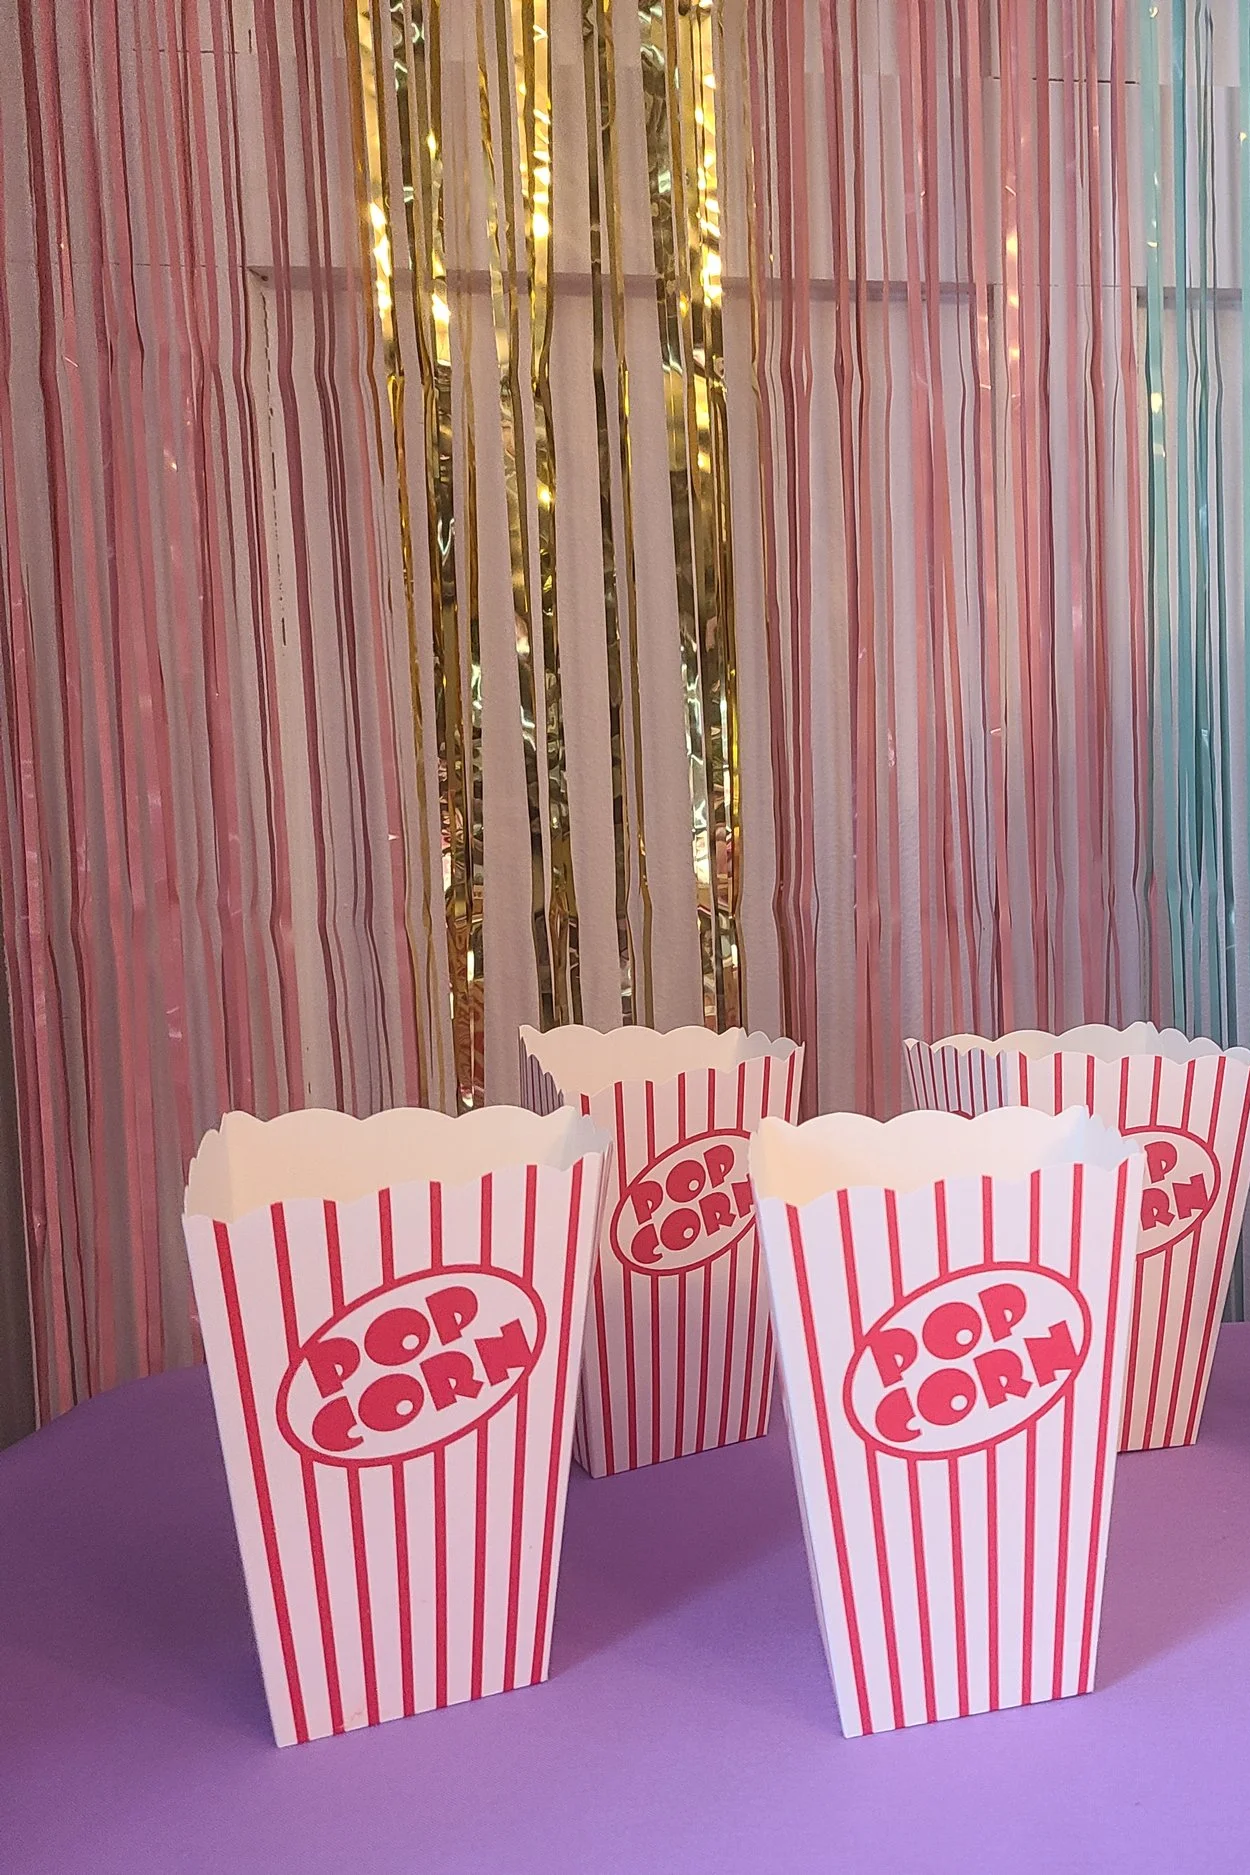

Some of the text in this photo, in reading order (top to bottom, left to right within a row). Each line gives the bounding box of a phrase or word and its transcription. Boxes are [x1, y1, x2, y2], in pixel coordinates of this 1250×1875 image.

[630, 1144, 735, 1224] POP
[630, 1173, 755, 1264] CORN
[1140, 1173, 1210, 1231] RN
[302, 1286, 478, 1398] POP
[311, 1318, 534, 1452] CORN
[867, 1283, 1027, 1387] POP
[875, 1320, 1080, 1442] CORN
